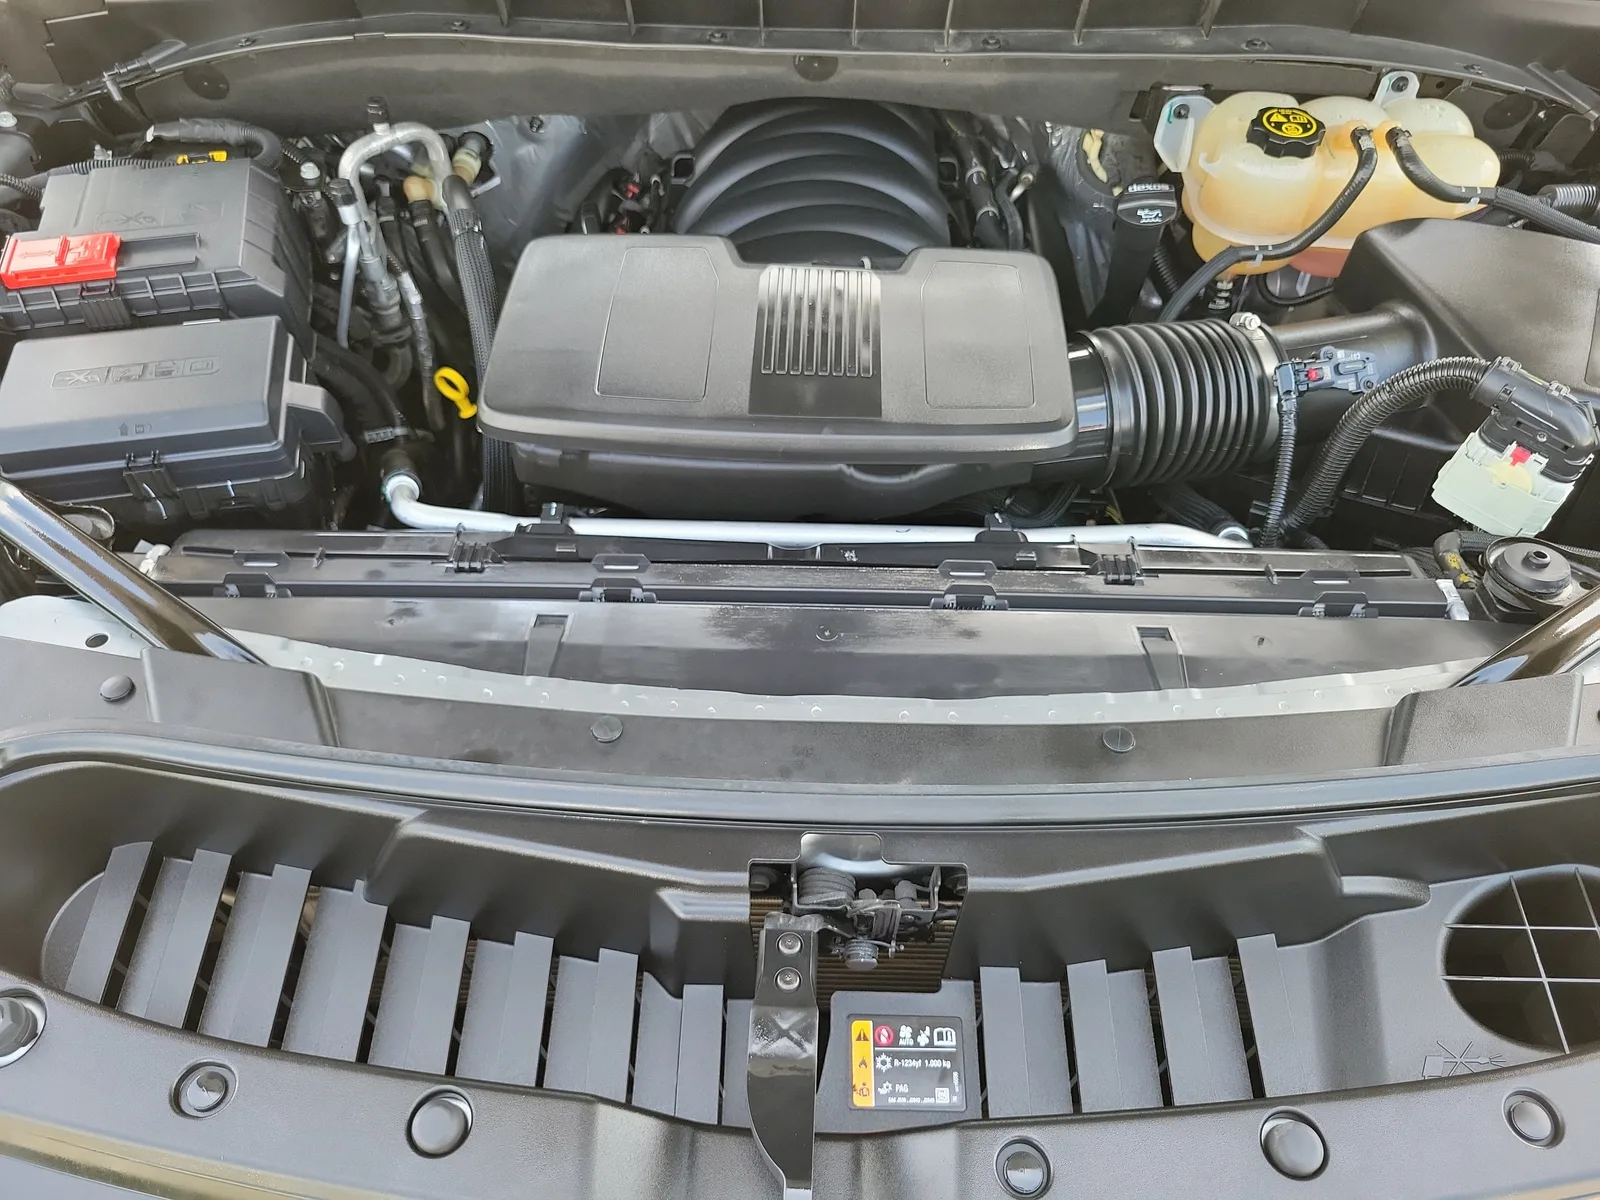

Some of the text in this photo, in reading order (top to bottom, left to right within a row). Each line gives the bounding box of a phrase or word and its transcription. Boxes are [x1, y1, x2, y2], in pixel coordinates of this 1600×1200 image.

[1128, 183, 1170, 193] dexos
[899, 1038, 914, 1046] AUTO
[894, 1059, 951, 1069] R-1234yf 1.000 kg
[895, 1084, 909, 1093] PAG
